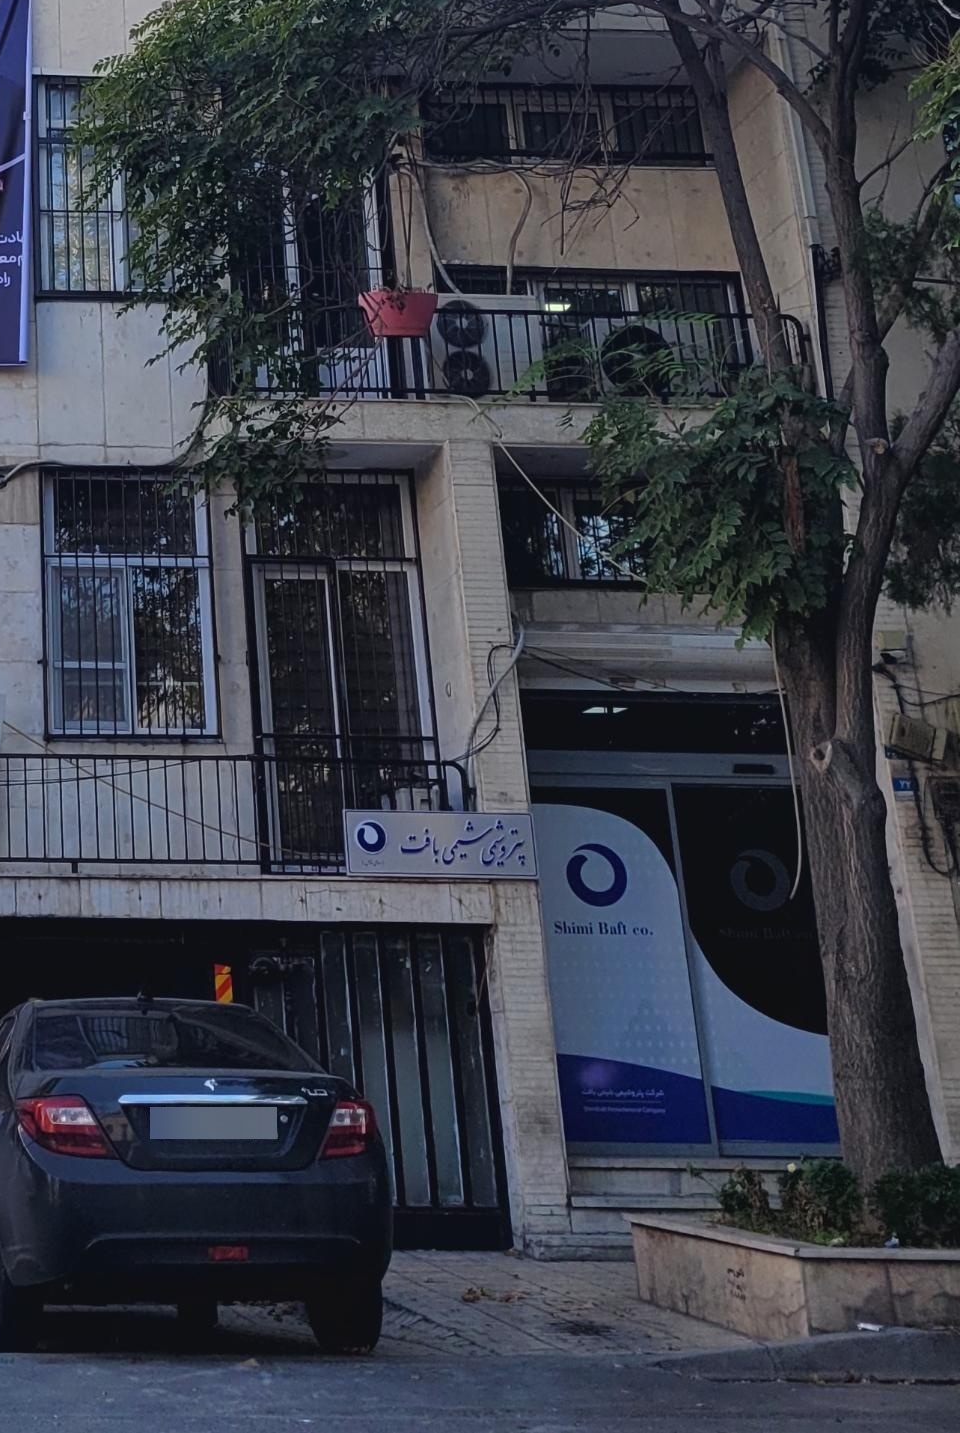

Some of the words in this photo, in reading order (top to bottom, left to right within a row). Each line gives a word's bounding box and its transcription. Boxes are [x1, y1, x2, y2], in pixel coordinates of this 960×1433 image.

[400, 828, 439, 864] بافت
[554, 920, 593, 936] Shimi
[598, 921, 627, 936] Baft
[632, 924, 654, 936] co.
